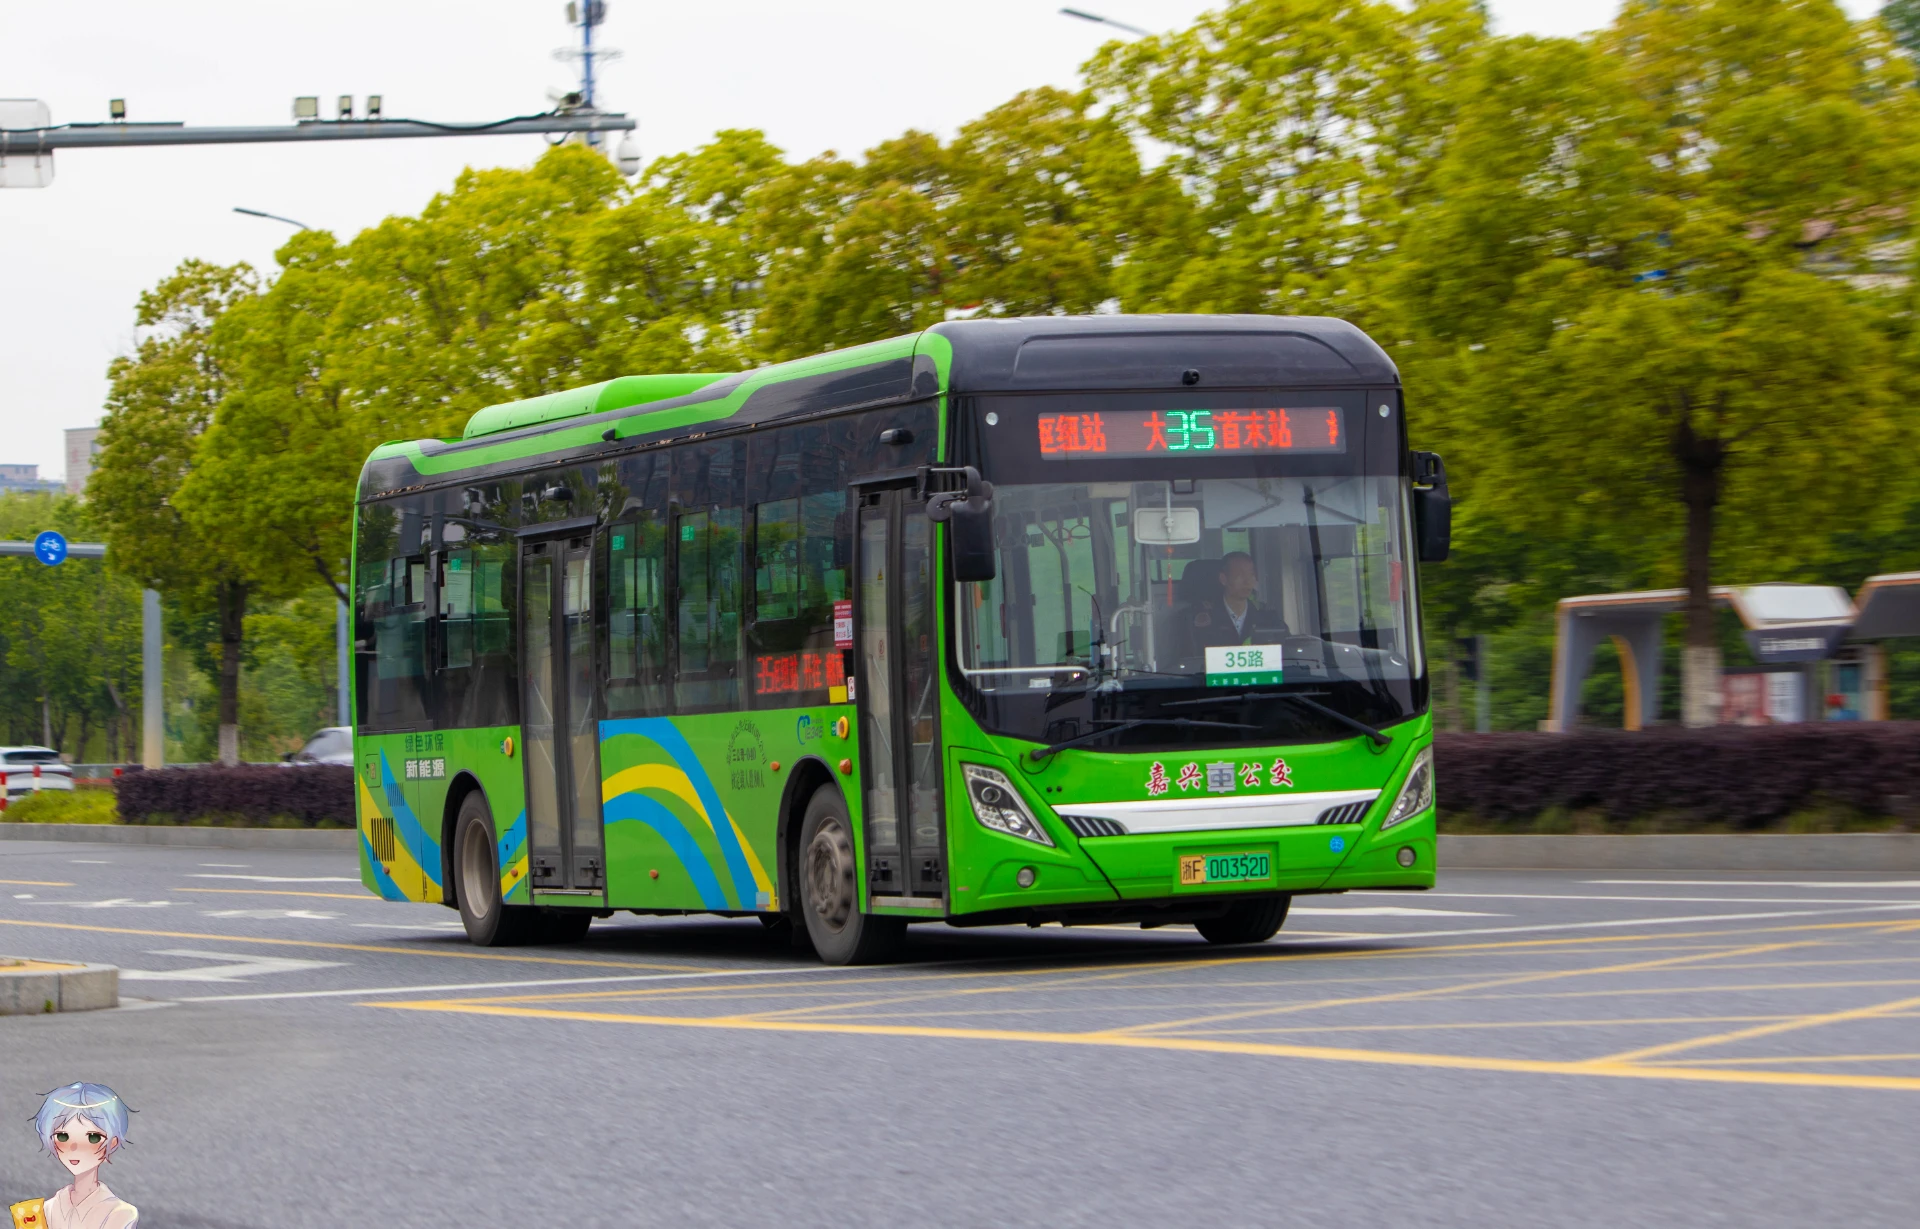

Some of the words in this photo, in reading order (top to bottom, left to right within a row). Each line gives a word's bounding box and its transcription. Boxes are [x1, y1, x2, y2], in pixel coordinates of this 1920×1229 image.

[1212, 409, 1292, 449] 首末站
[1225, 650, 1264, 668] 35路
[405, 733, 444, 753] 绿色环保
[406, 759, 445, 778] 新能源
